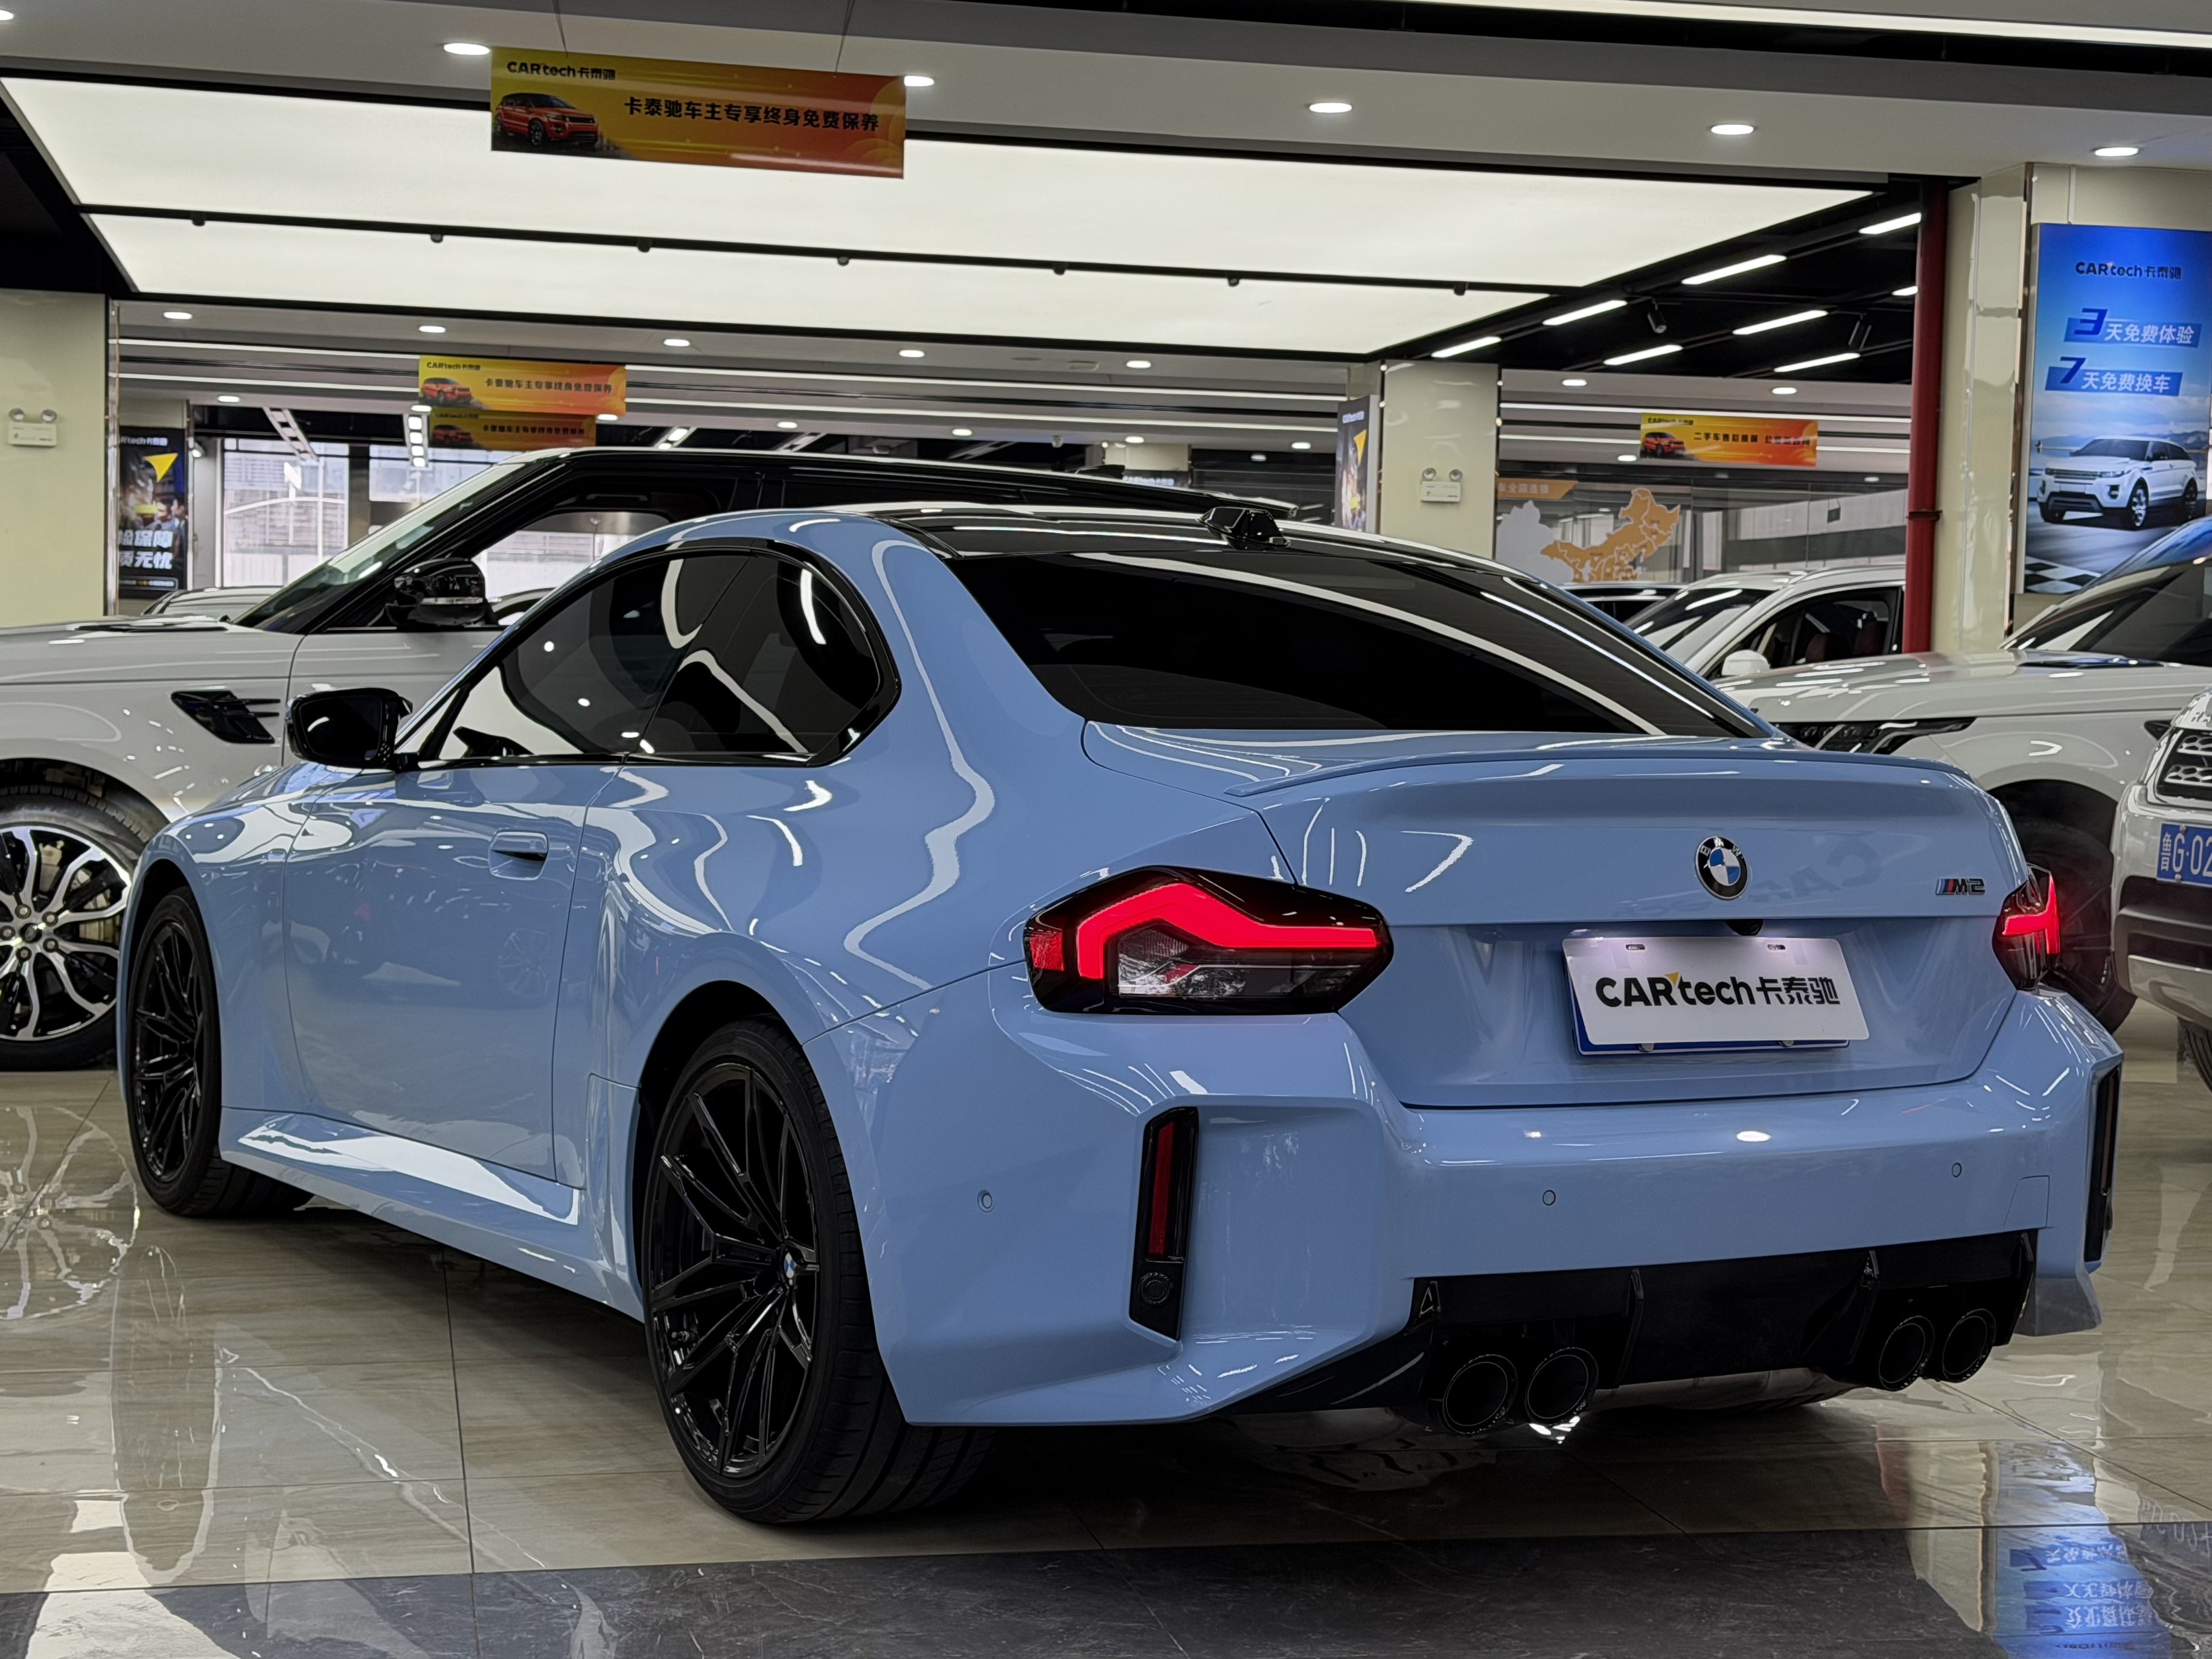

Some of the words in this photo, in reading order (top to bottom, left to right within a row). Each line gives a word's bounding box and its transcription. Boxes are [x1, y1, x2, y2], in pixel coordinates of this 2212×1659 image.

[624, 96, 879, 132] 卡泰驰车主专享终身免费保养
[1699, 837, 1742, 857] BMW
[1948, 878, 1986, 895] M2
[1595, 975, 1841, 1008] CARtech卡泰驰
